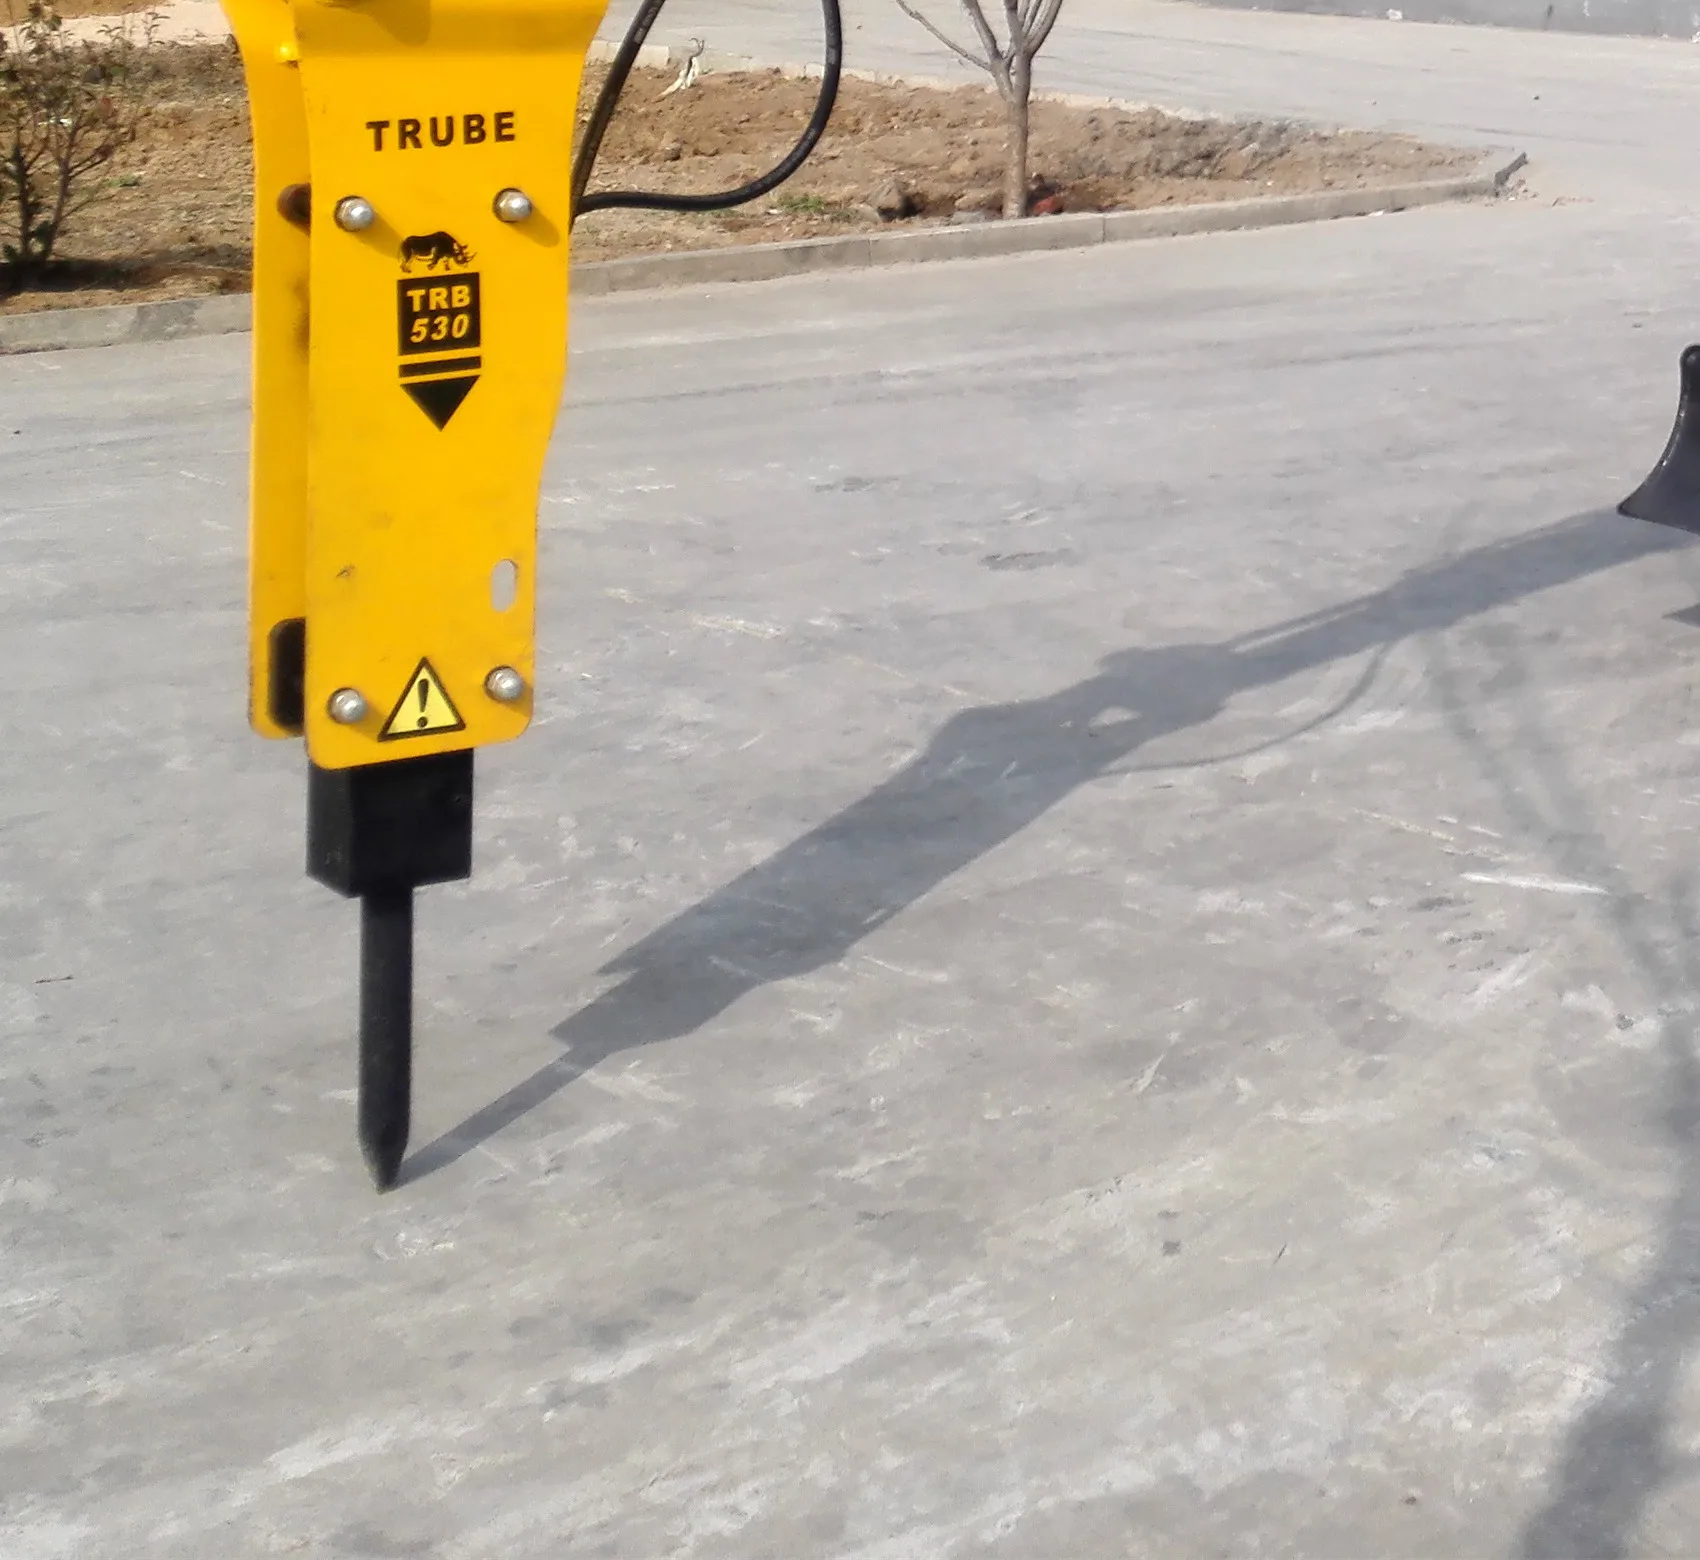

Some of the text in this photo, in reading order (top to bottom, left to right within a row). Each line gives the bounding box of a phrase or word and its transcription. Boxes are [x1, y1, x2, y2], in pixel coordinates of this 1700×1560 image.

[366, 112, 515, 151] TRUBE
[406, 285, 471, 313] TRB
[409, 313, 469, 343] 530
